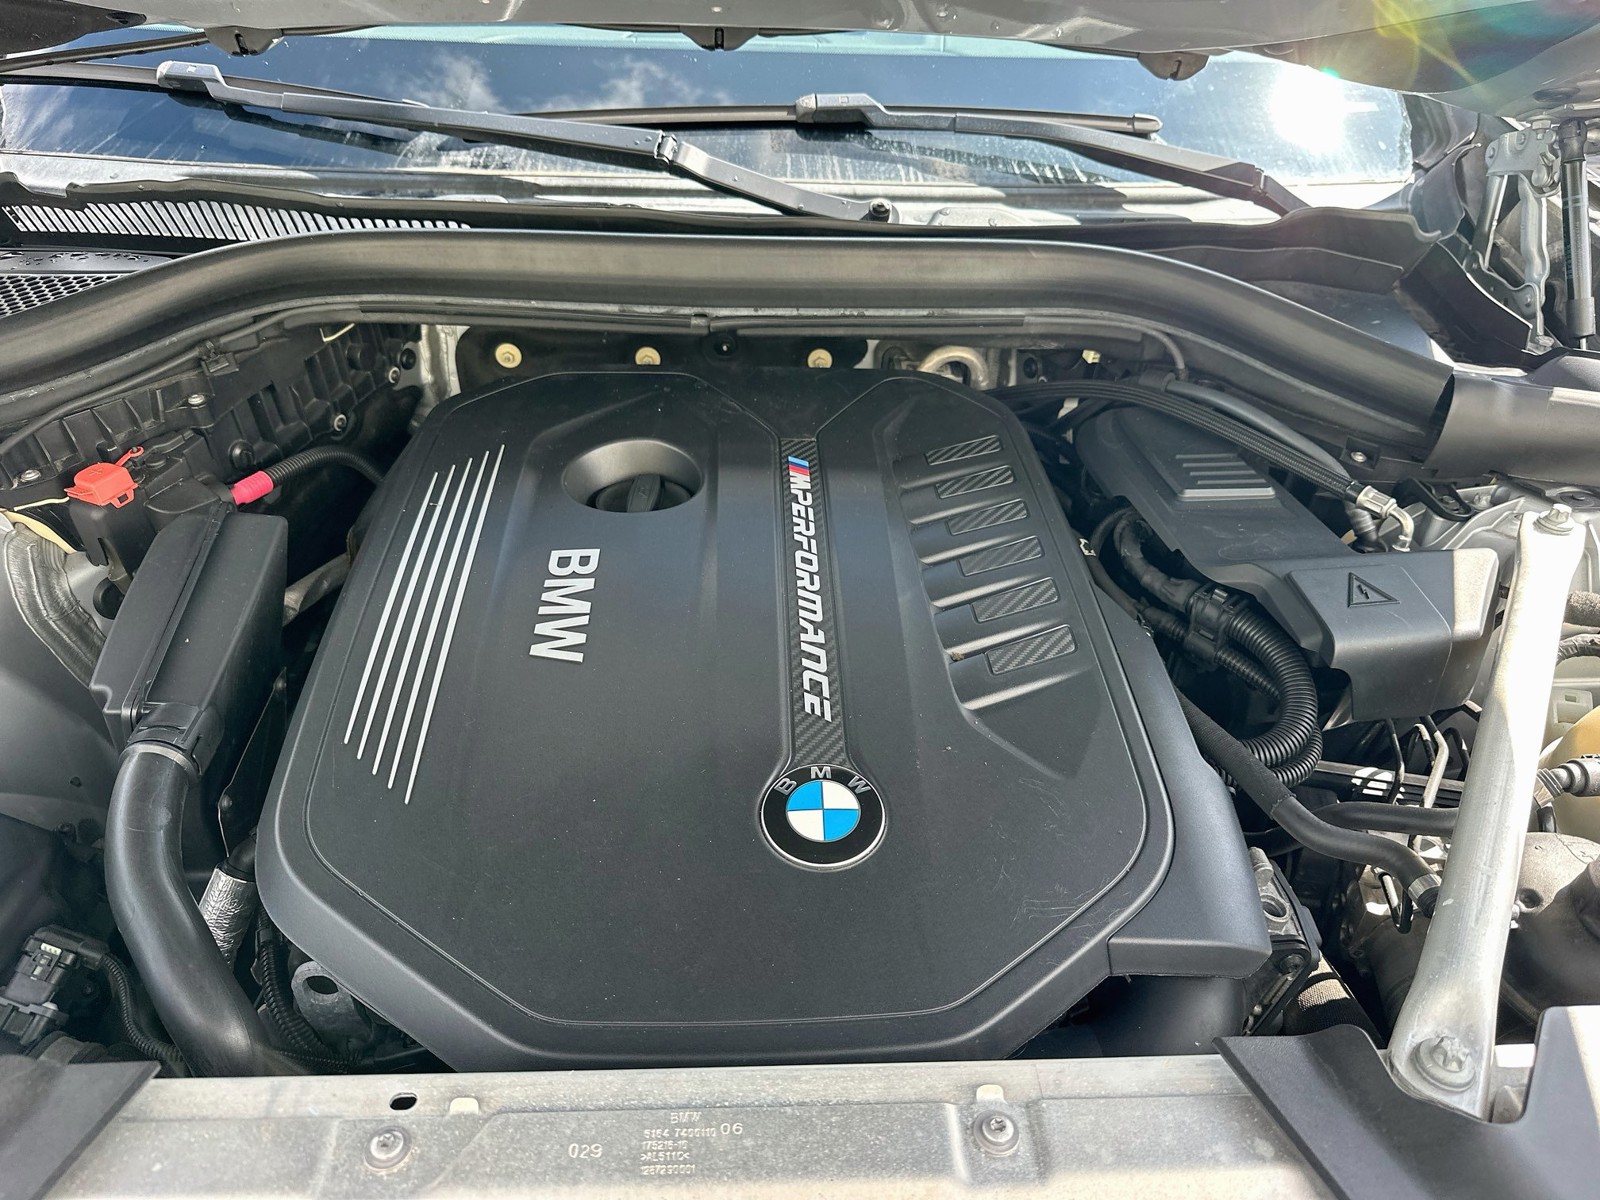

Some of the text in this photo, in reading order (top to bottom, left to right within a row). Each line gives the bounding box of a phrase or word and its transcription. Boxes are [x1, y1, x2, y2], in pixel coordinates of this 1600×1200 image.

[529, 549, 600, 662] BMW
[774, 766, 871, 795] BMW
[720, 1122, 743, 1135] 06
[568, 1143, 603, 1159] 029
